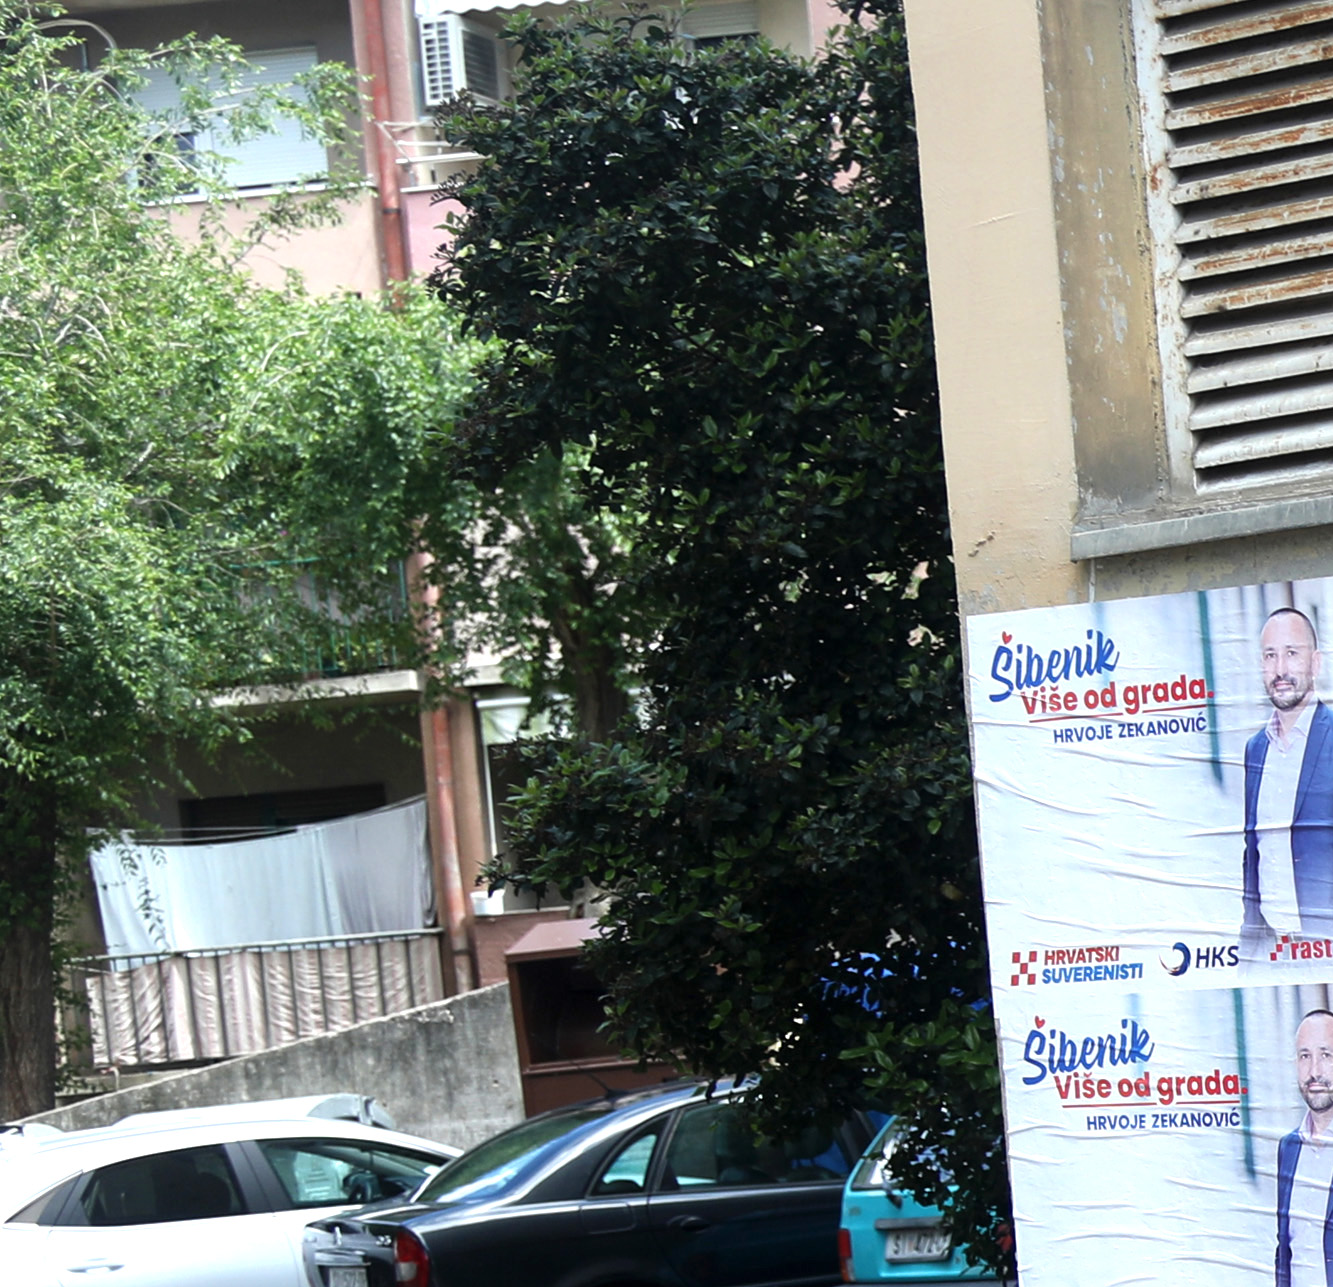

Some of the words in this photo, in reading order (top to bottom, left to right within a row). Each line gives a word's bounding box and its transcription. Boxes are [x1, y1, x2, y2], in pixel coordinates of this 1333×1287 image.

[989, 630, 1120, 701] Šibenik
[1021, 689, 1077, 715] Više
[1083, 681, 1115, 712] od
[1123, 674, 1214, 715] grada.
[1053, 722, 1113, 744] HRVOJE
[1117, 712, 1207, 739] ZEKANOVIĆ
[1044, 946, 1119, 965] HRVATSKI
[1195, 945, 1239, 968] HKS
[1290, 937, 1332, 959] rast
[1042, 964, 1143, 984] SUVERENISTI
